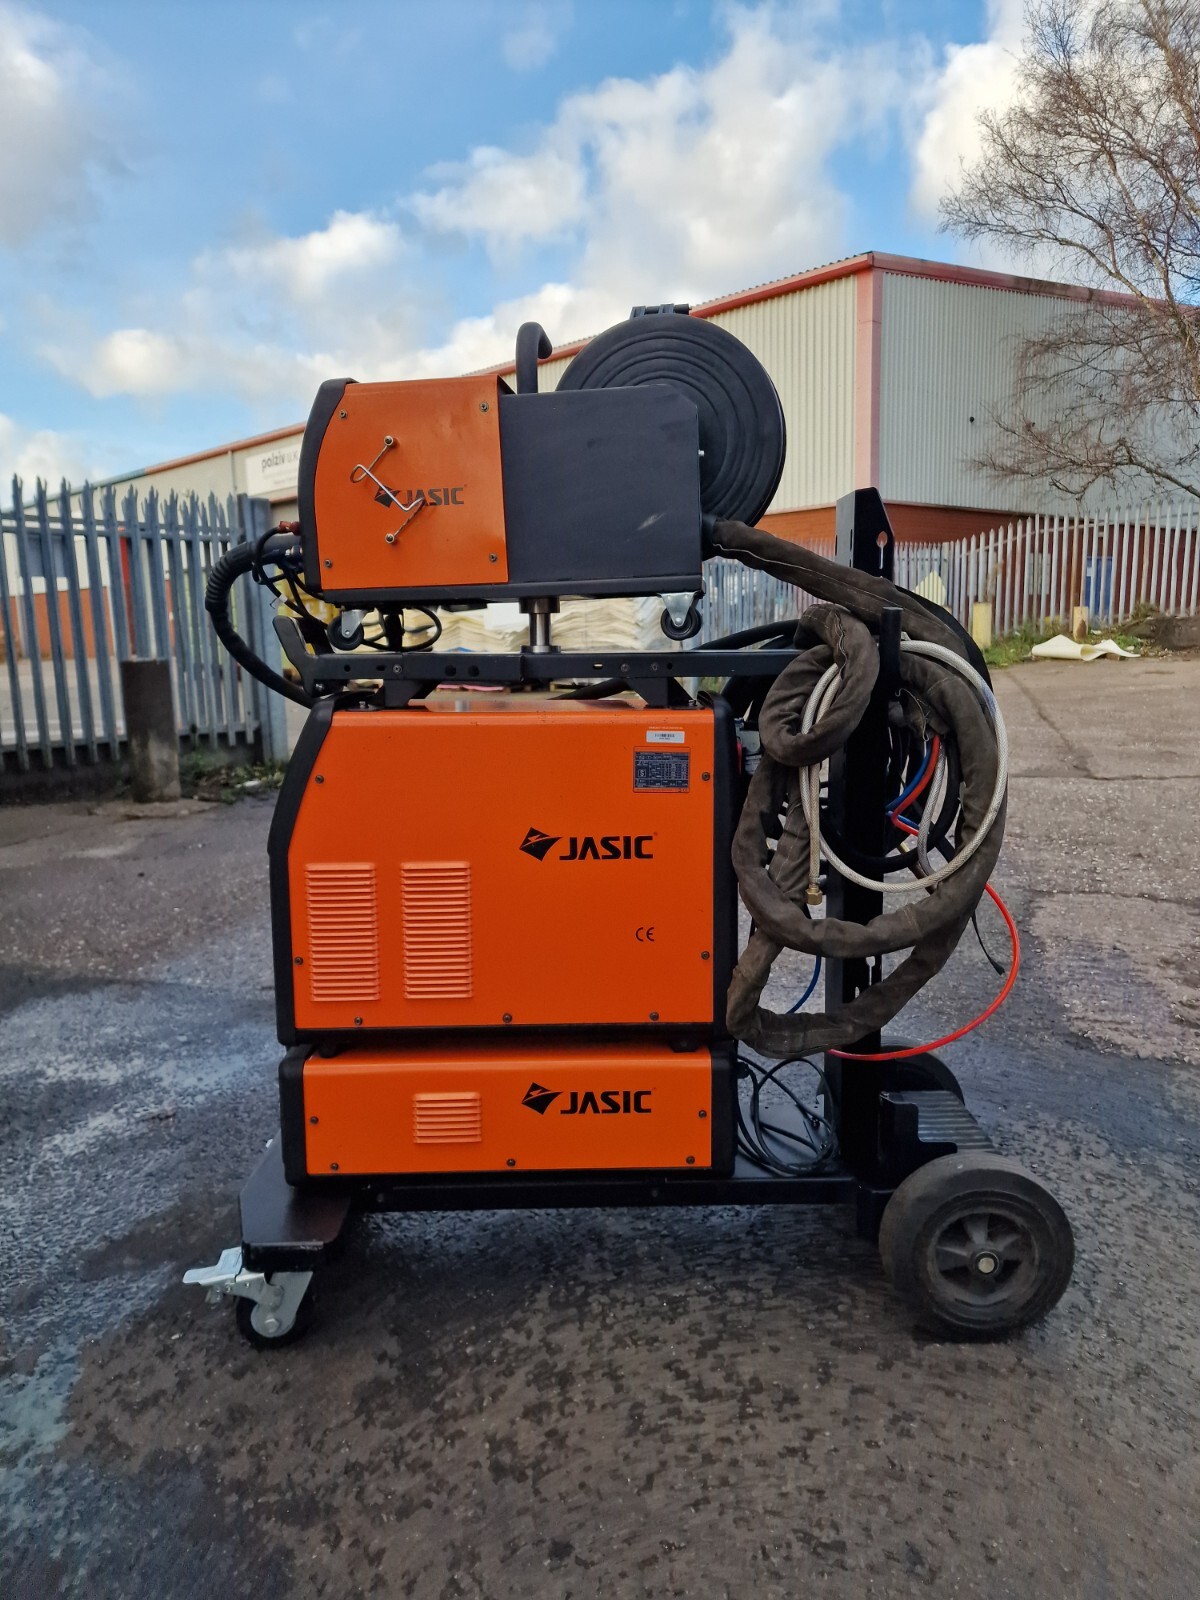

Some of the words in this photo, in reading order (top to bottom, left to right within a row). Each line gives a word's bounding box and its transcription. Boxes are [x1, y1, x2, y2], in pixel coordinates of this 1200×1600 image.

[402, 487, 464, 506] JASIC
[559, 836, 653, 860] JASIC
[635, 926, 655, 942] CE
[560, 1091, 651, 1114] JASIC
